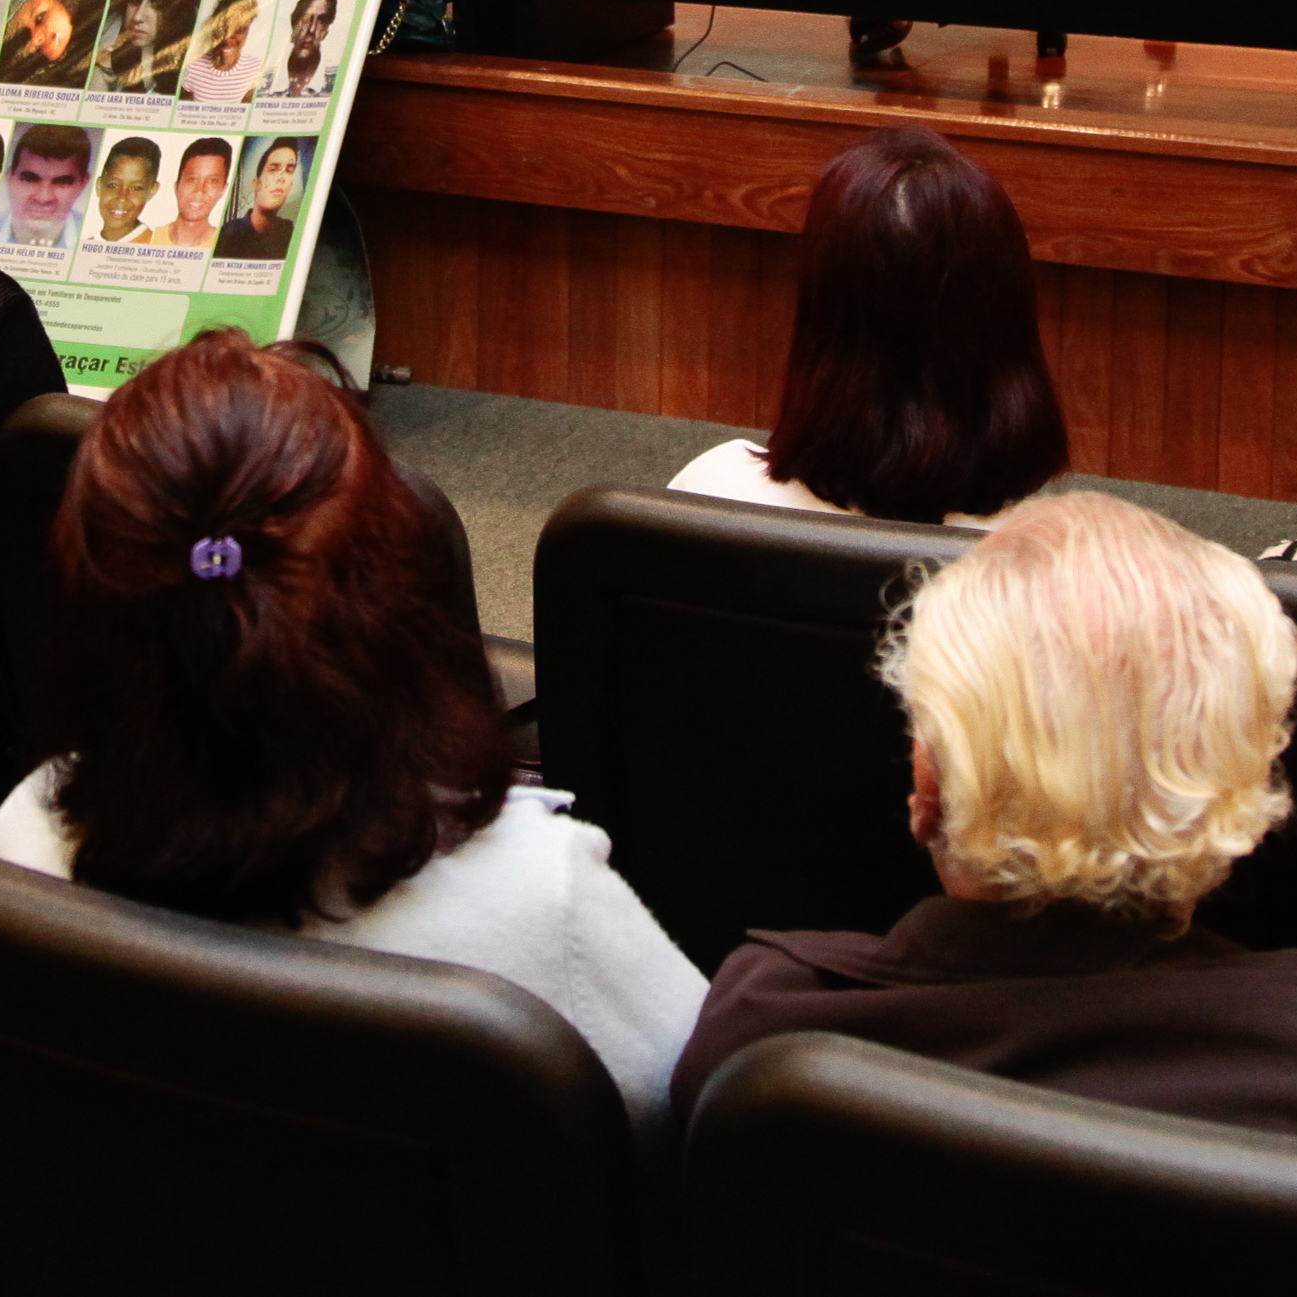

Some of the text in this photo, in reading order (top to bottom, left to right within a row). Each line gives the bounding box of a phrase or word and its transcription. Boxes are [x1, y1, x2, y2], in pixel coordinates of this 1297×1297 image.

[23, 90, 54, 100] RIBEIRO
[56, 92, 80, 102] SOUZA
[84, 93, 106, 103] JOICE
[107, 95, 124, 105] IARA
[125, 96, 146, 106] VEIGA
[47, 251, 65, 260] MELO
[82, 244, 204, 260] HUGO RIBEIRO SANTOS CAMARGO
[60, 355, 147, 377] raçar Est
